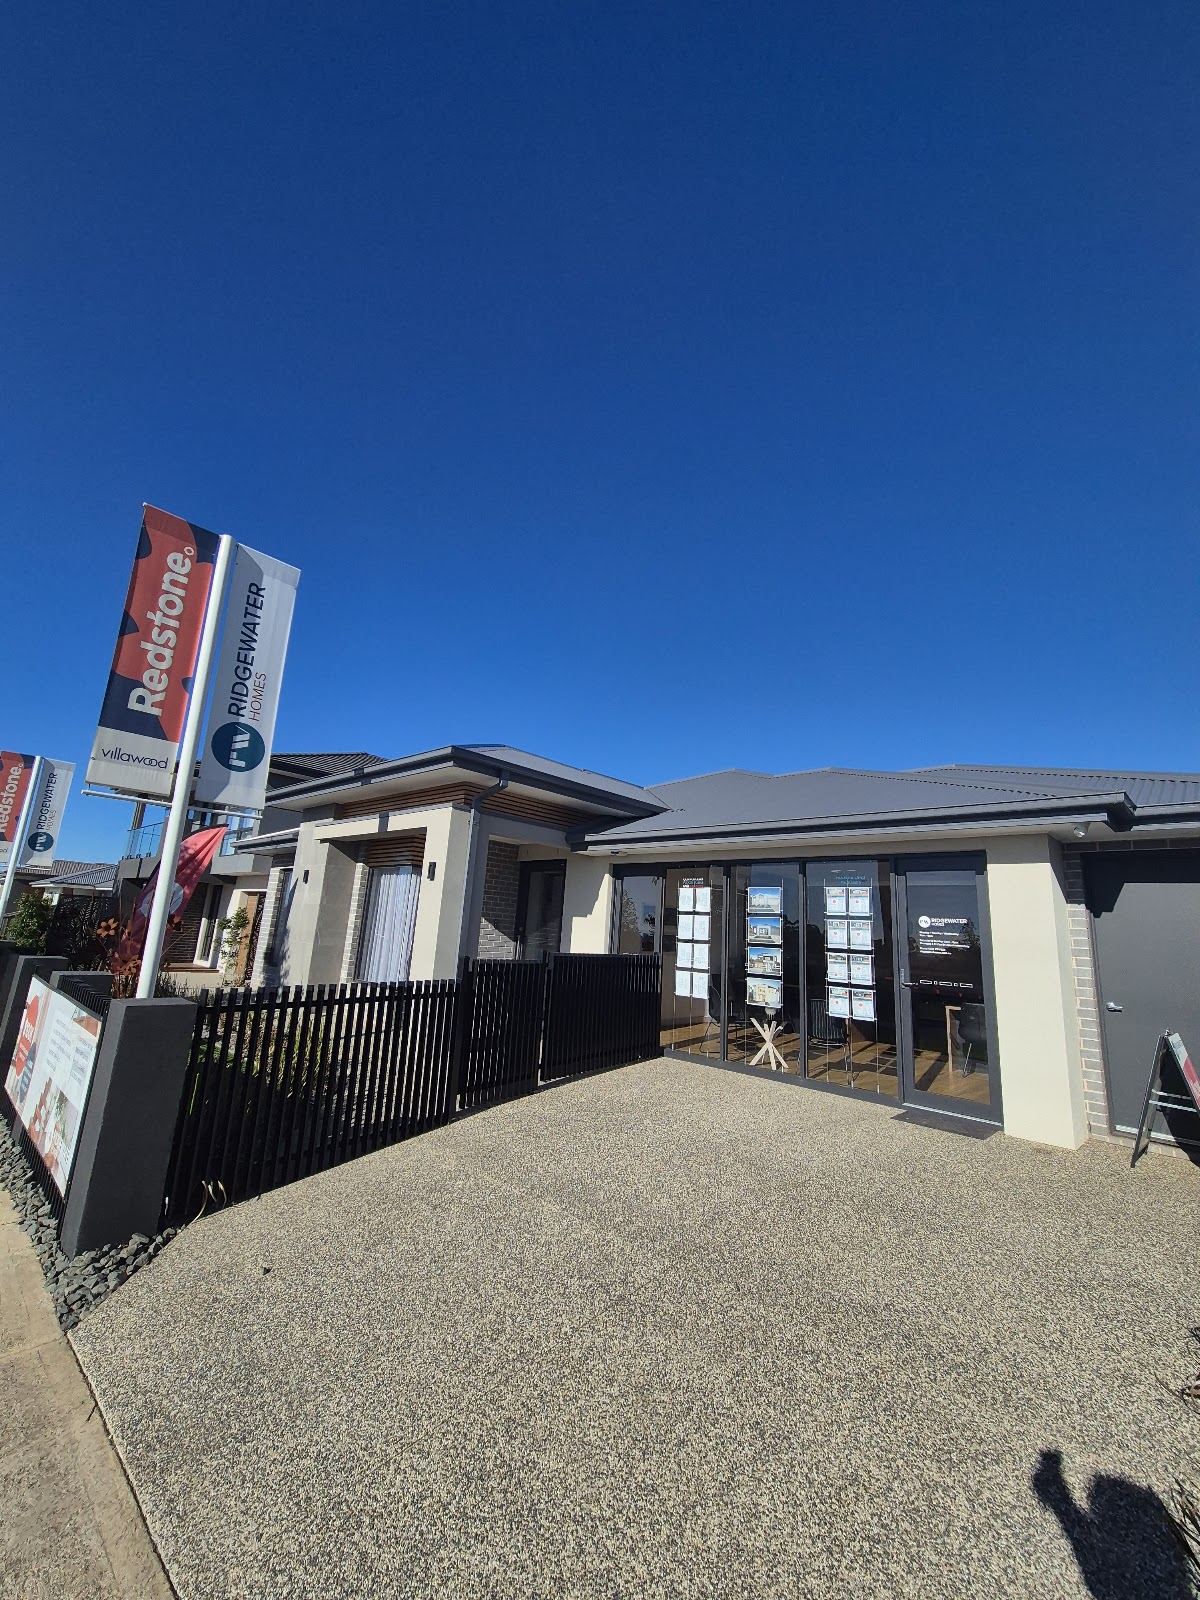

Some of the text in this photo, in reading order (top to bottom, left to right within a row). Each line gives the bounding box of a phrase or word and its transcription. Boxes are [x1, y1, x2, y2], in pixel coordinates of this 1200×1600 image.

[227, 582, 266, 718] RIDGEWATER
[248, 672, 267, 722] HOMES
[101, 748, 169, 770] villawood
[36, 772, 58, 830] RIDGEWATER
